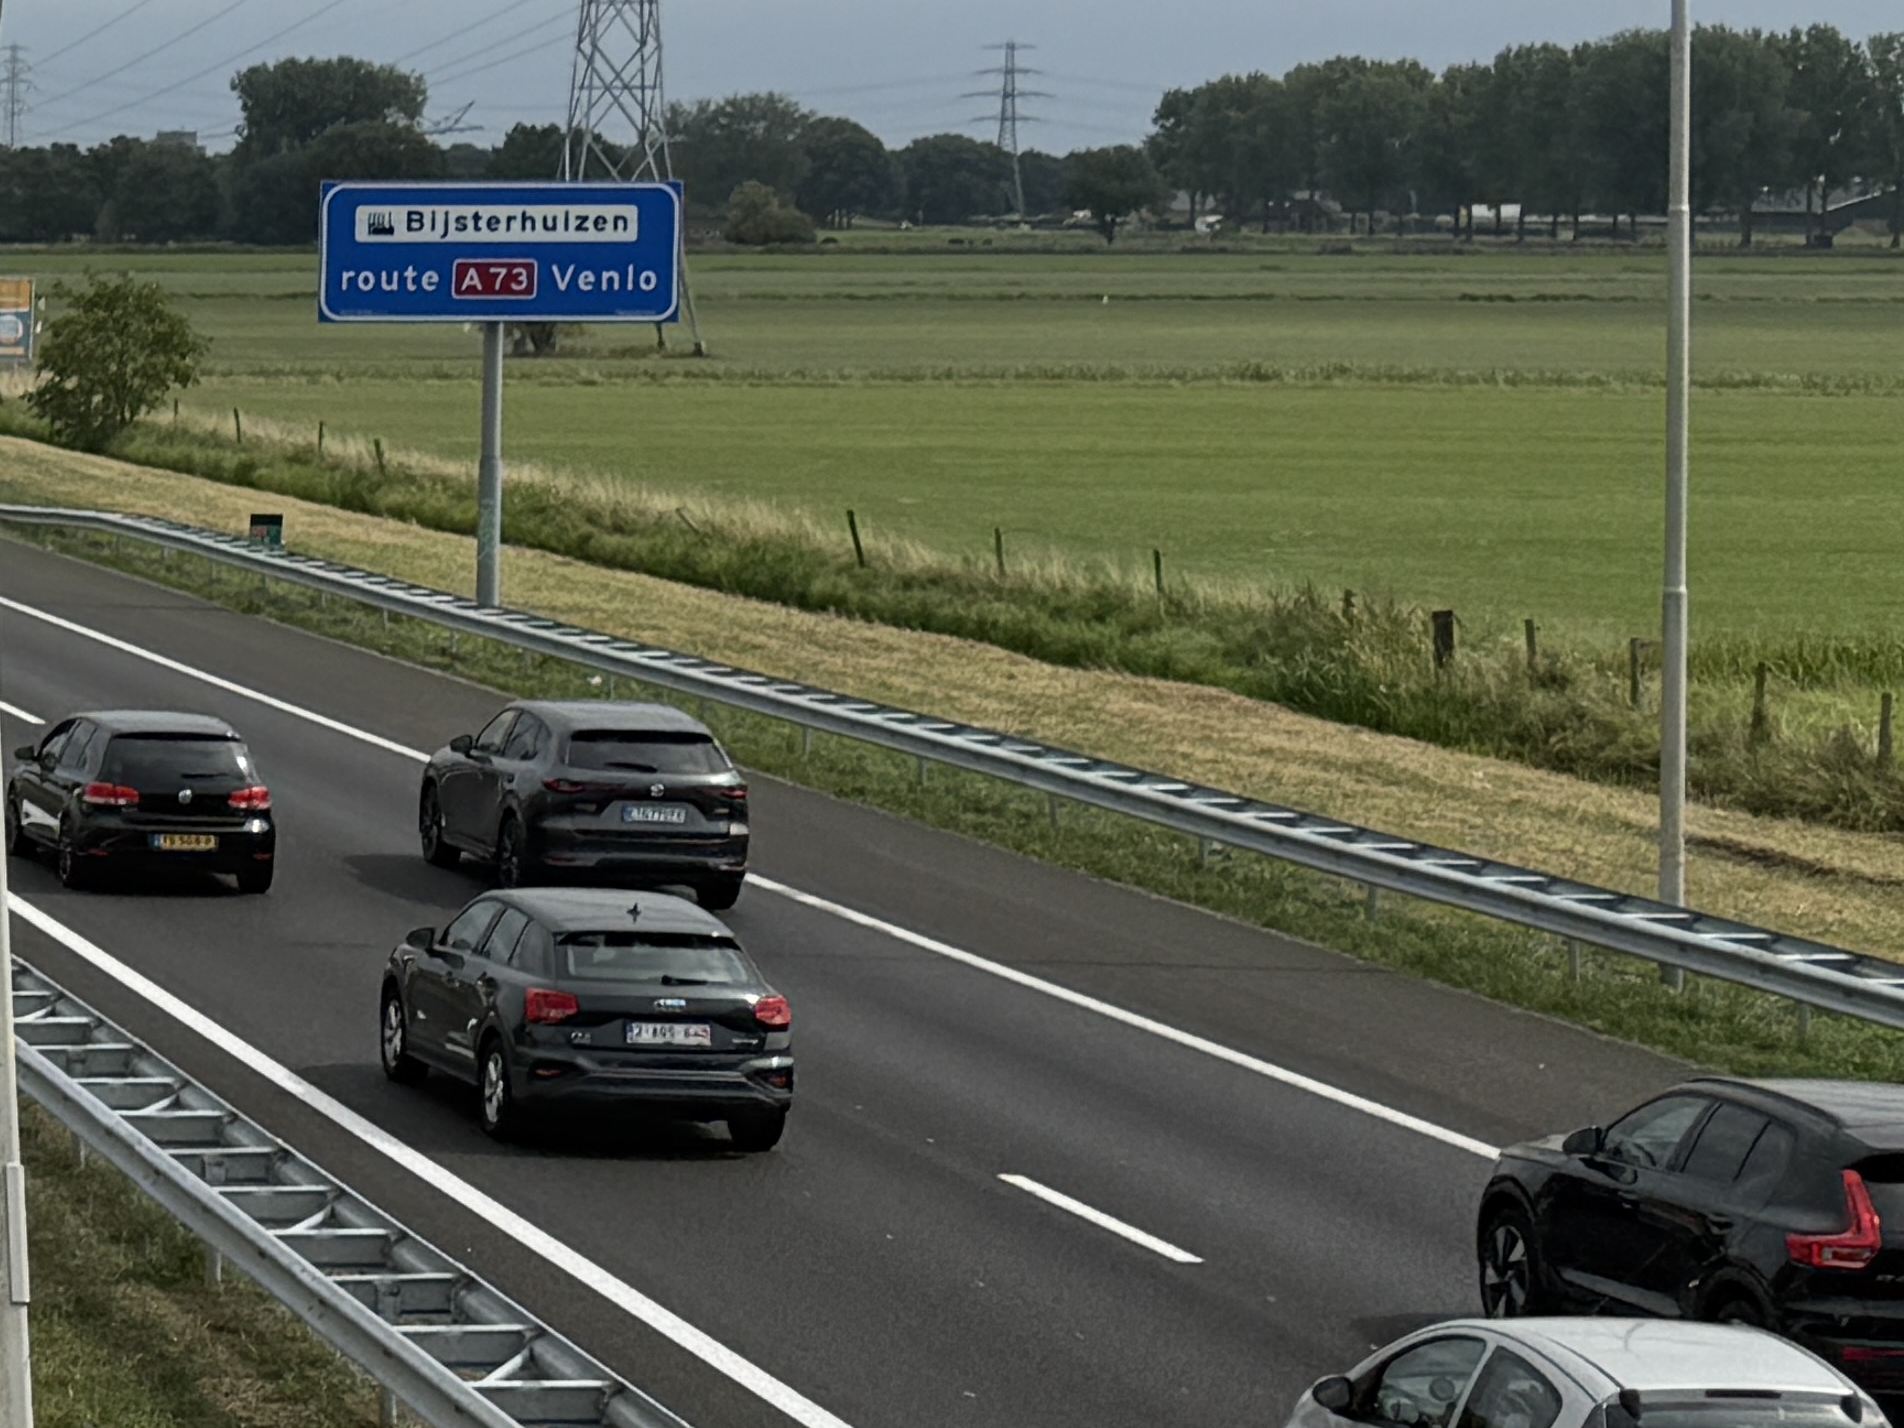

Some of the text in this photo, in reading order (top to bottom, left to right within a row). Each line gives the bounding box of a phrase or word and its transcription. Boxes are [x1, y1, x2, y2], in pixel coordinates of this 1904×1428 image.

[405, 209, 629, 239] Bijsterhuizen
[341, 265, 440, 292] route
[551, 263, 658, 292] Venlo
